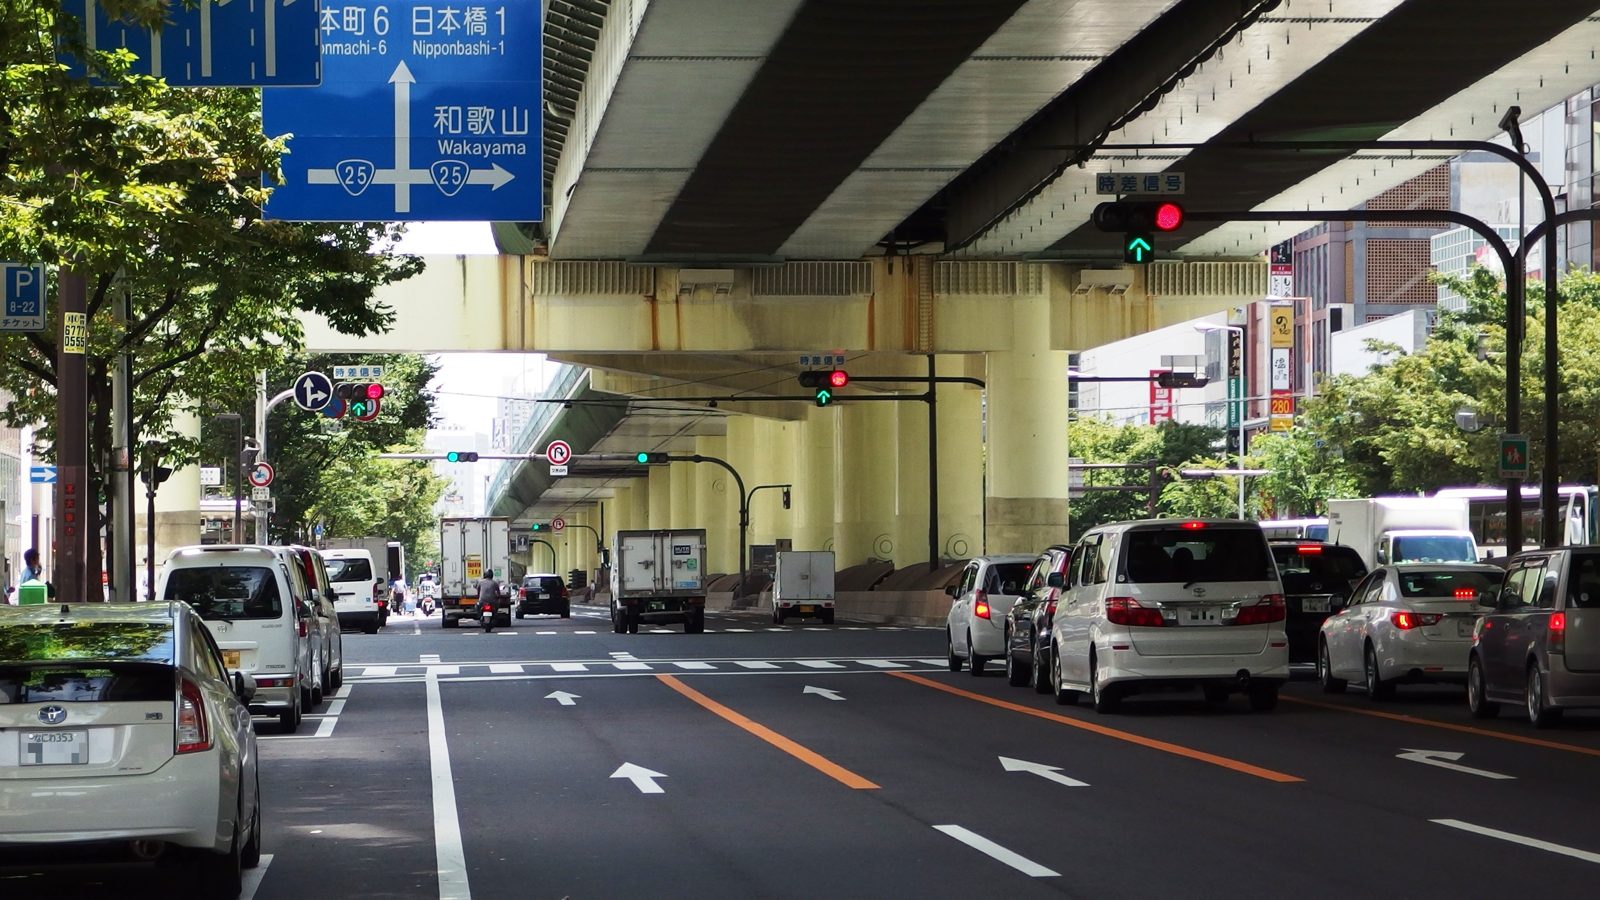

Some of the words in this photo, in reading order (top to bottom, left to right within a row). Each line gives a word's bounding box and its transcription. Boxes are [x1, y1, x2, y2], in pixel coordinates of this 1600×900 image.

[413, 40, 504, 59] Nipponbashi-1
[433, 105, 528, 135] 和歌山
[437, 139, 526, 158] Wakayama
[345, 166, 367, 185] 25
[440, 166, 461, 185] 25
[1099, 175, 1181, 192] 時差信号
[16, 270, 33, 297] P
[10, 301, 35, 313] 8-22
[2, 319, 40, 327] チケット
[1272, 400, 1290, 414] 280
